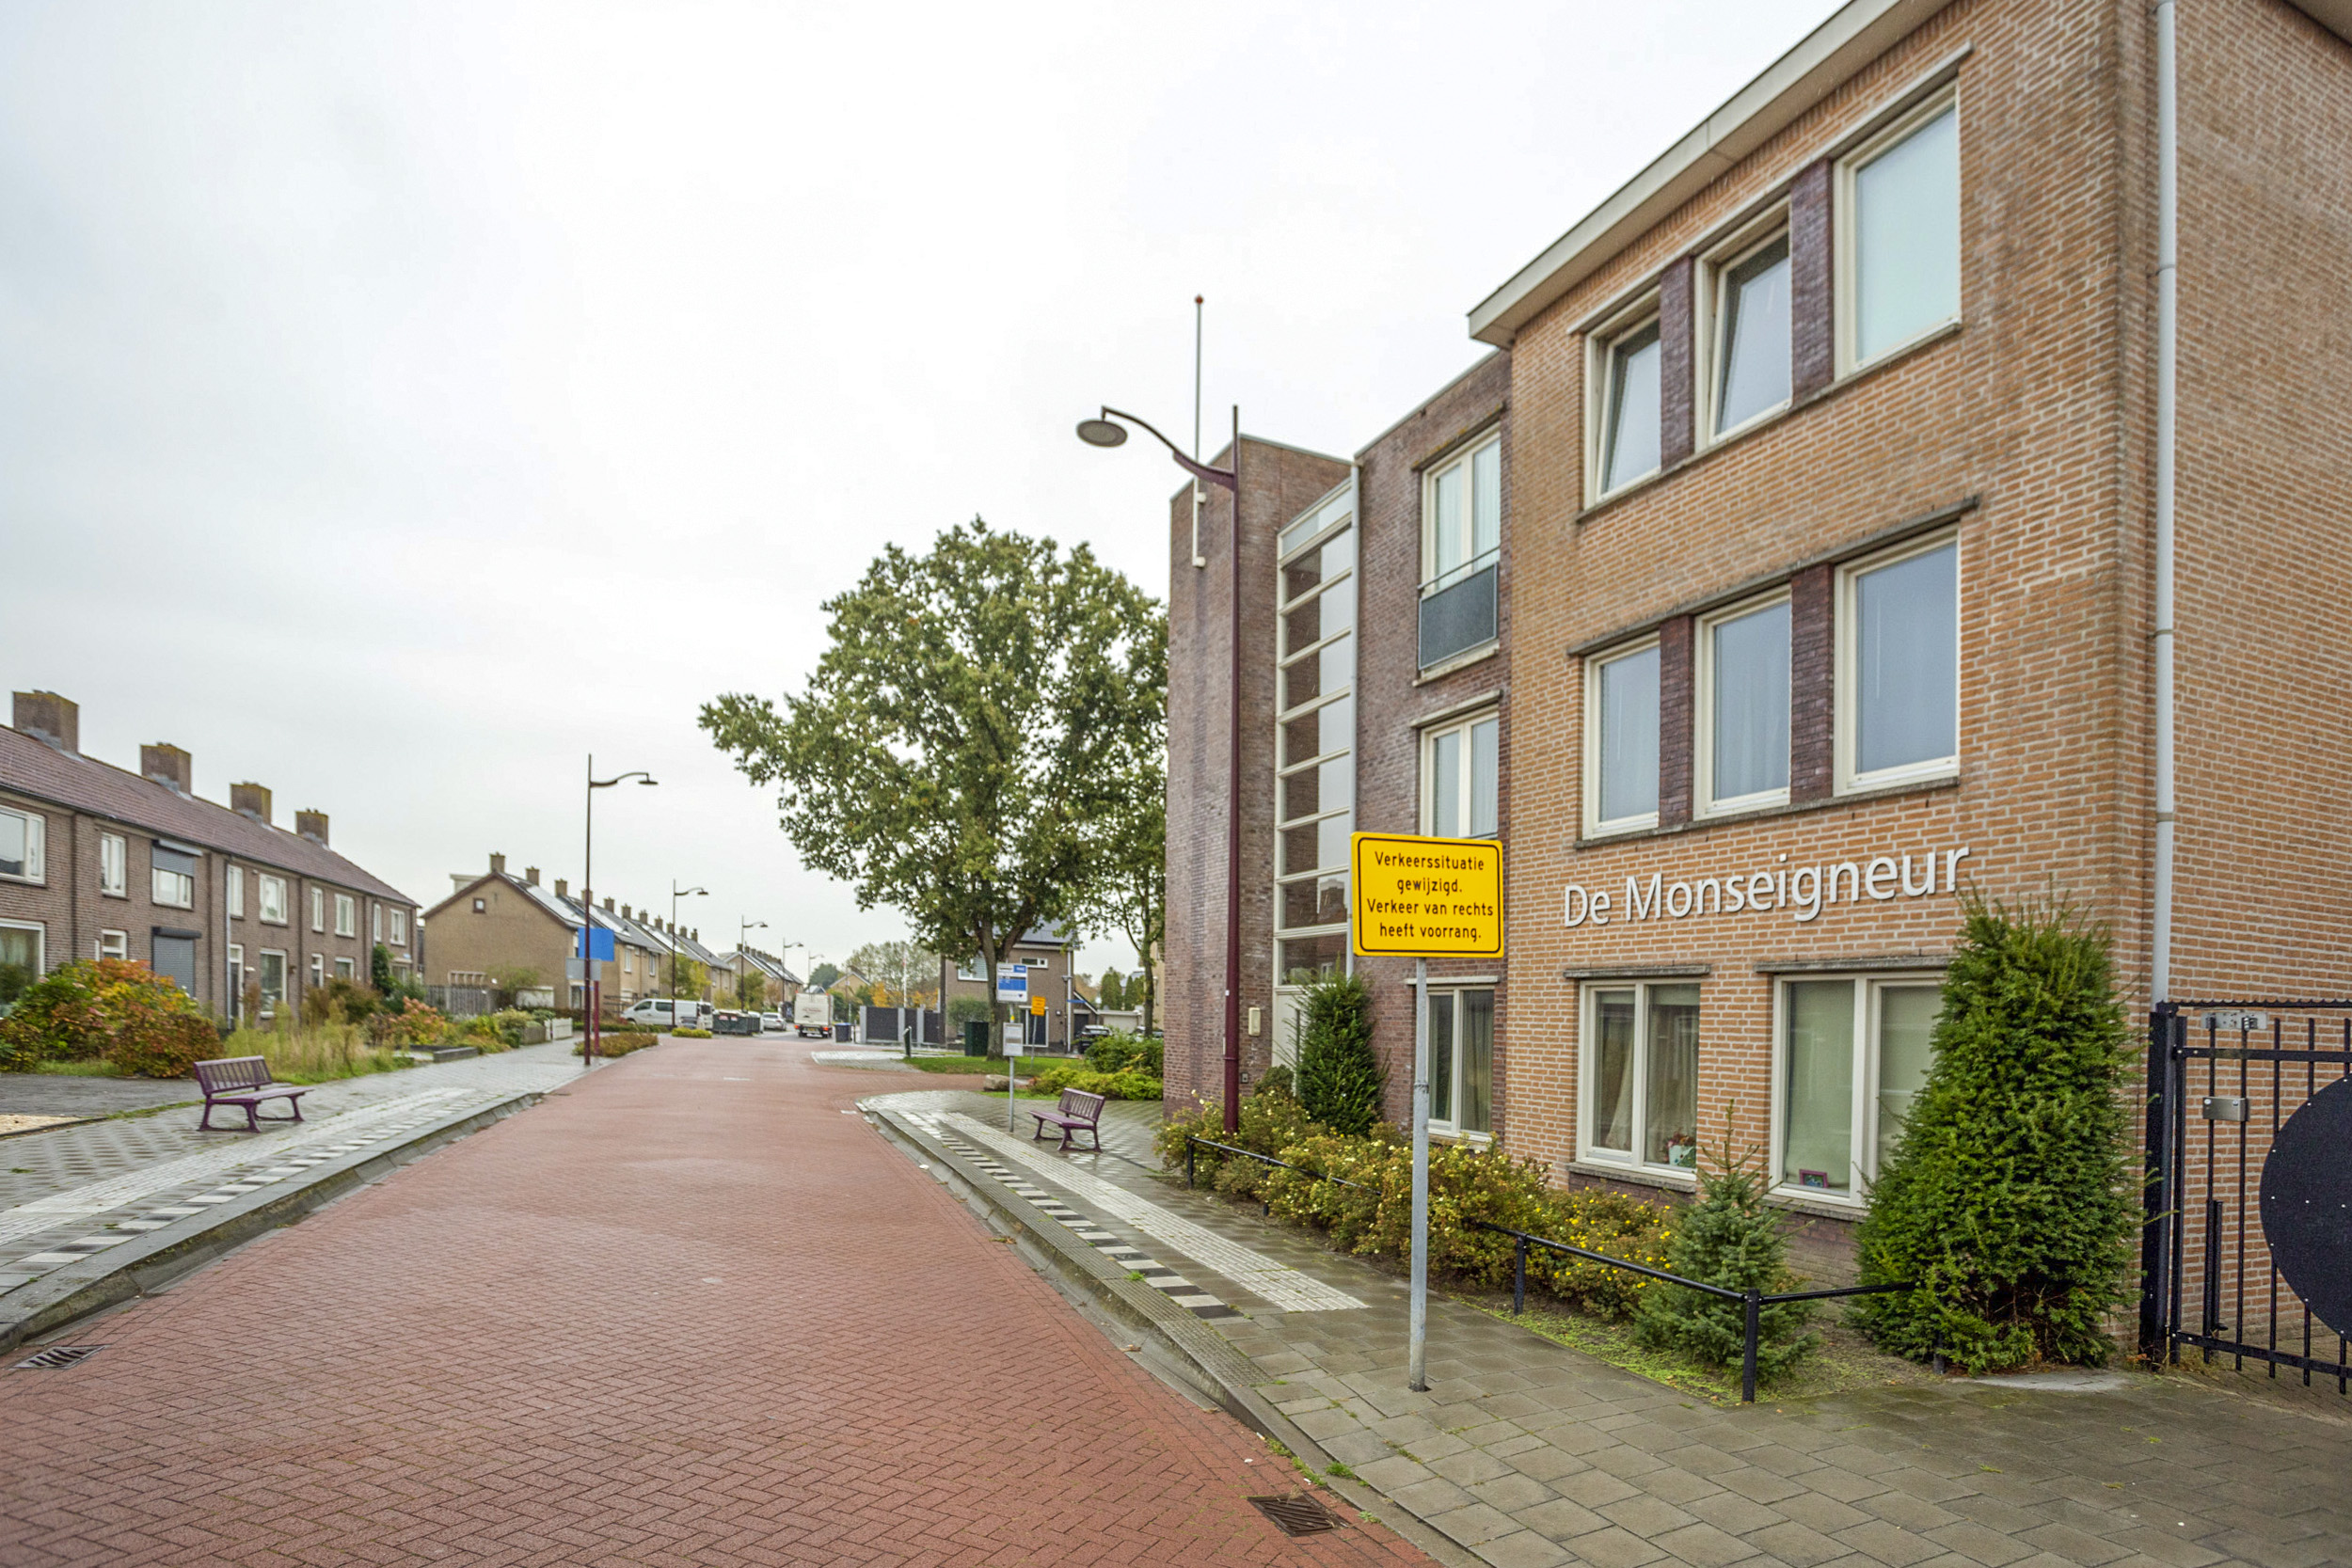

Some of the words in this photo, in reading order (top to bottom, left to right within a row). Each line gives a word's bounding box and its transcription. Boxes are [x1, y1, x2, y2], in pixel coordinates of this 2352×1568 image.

[1375, 851, 1485, 871] Verkeerssituatie
[1397, 877, 1463, 895] gewijzigd.
[1565, 884, 1611, 927] De
[1626, 847, 1970, 923] Monseigneur
[1367, 898, 1419, 914] Verkeer
[1424, 903, 1447, 915] van
[1453, 902, 1494, 916] rechts
[1379, 923, 1414, 937] heeft
[1420, 926, 1482, 942] voorrang.
